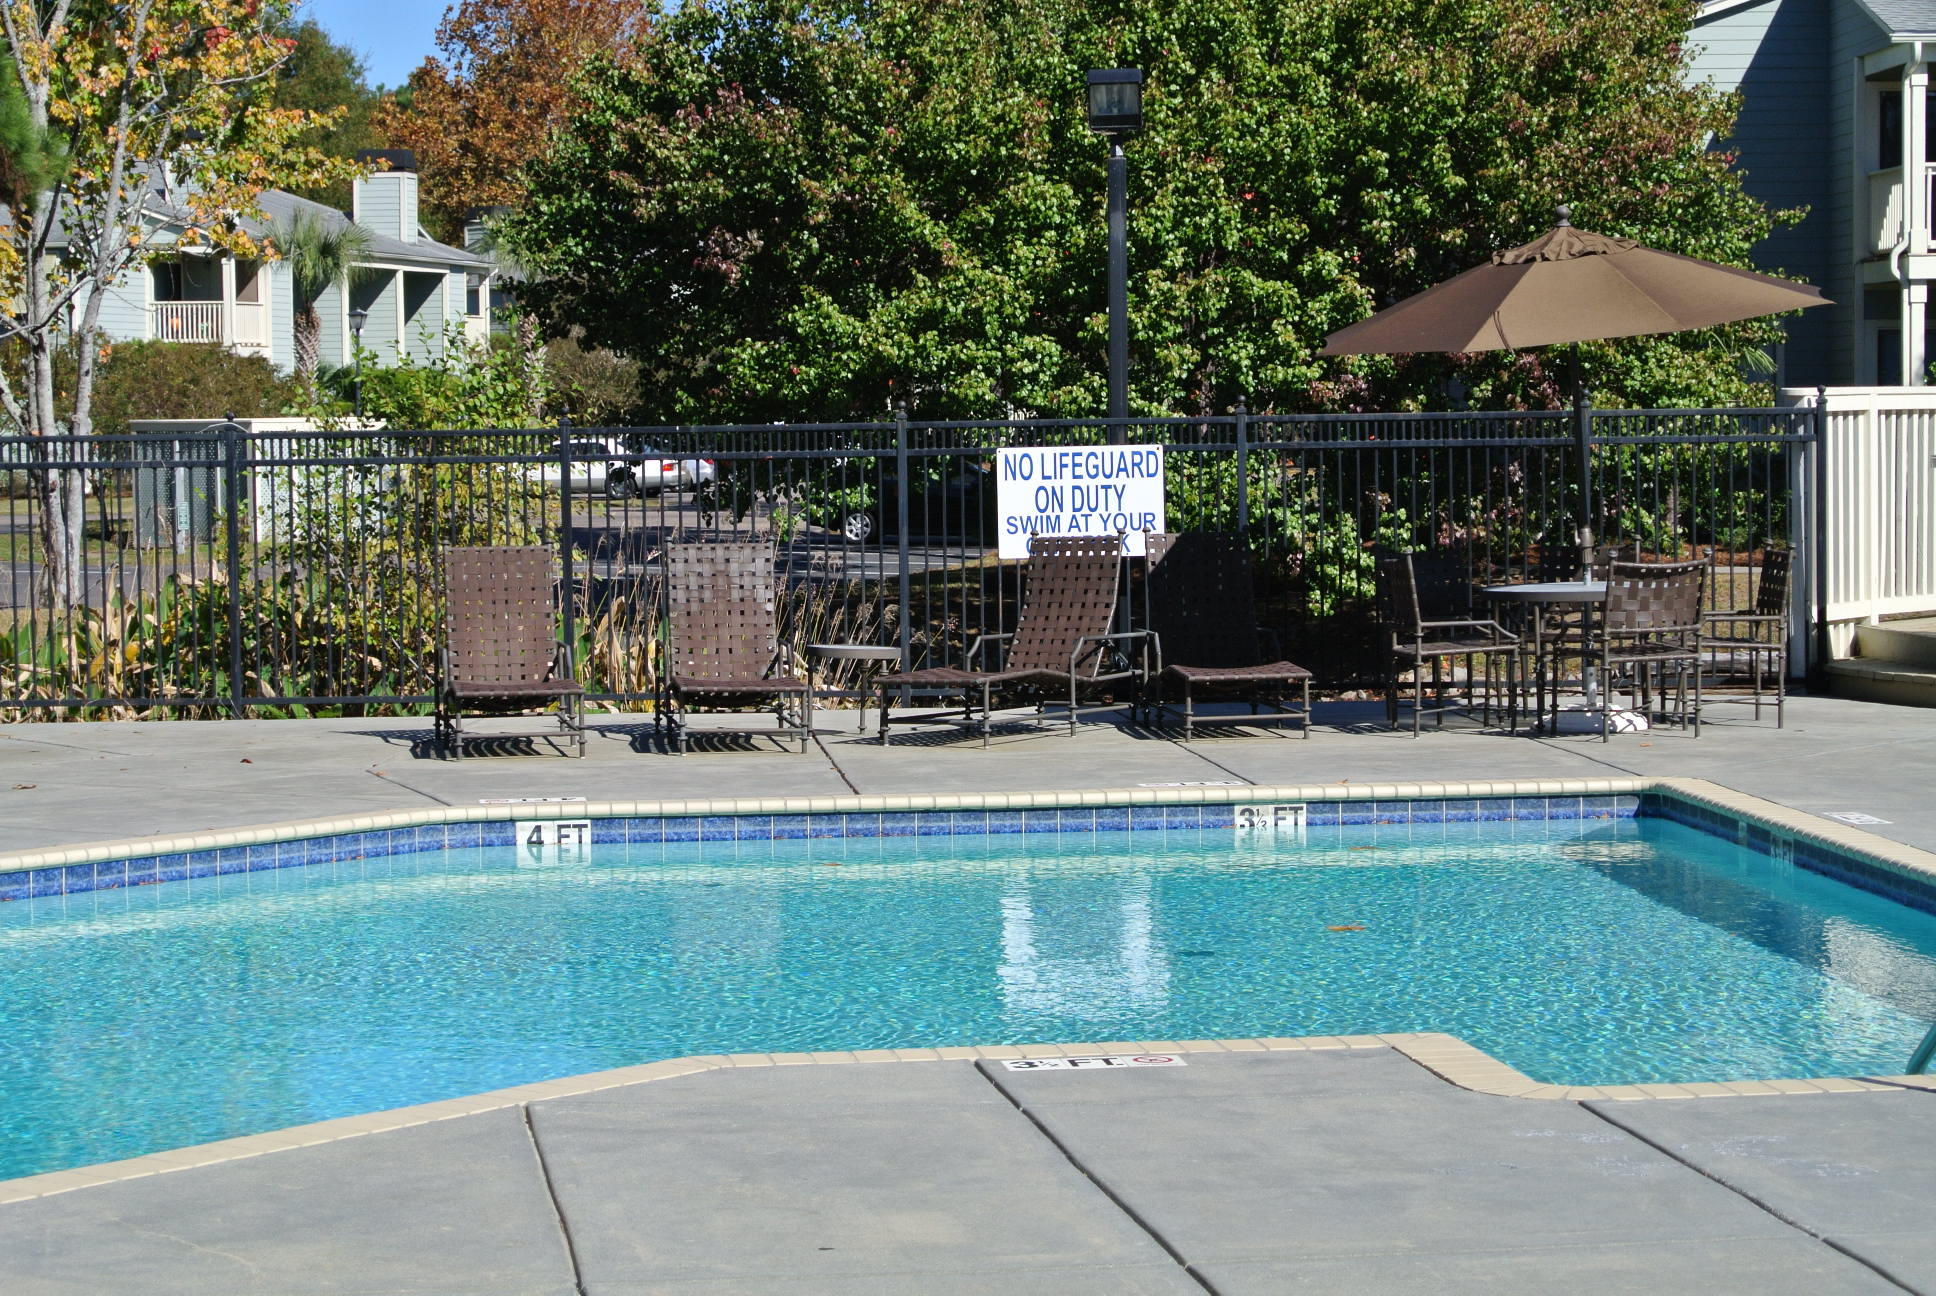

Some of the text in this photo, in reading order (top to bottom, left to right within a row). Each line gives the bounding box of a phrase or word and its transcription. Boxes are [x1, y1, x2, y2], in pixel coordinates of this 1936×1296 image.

[1004, 451, 1159, 481] NO LIFEGUARD
[1035, 484, 1126, 513] ON DUTY
[1006, 512, 1157, 535] SWIM AT YOUR
[1274, 806, 1304, 827] FT
[527, 823, 589, 845] 4 FT
